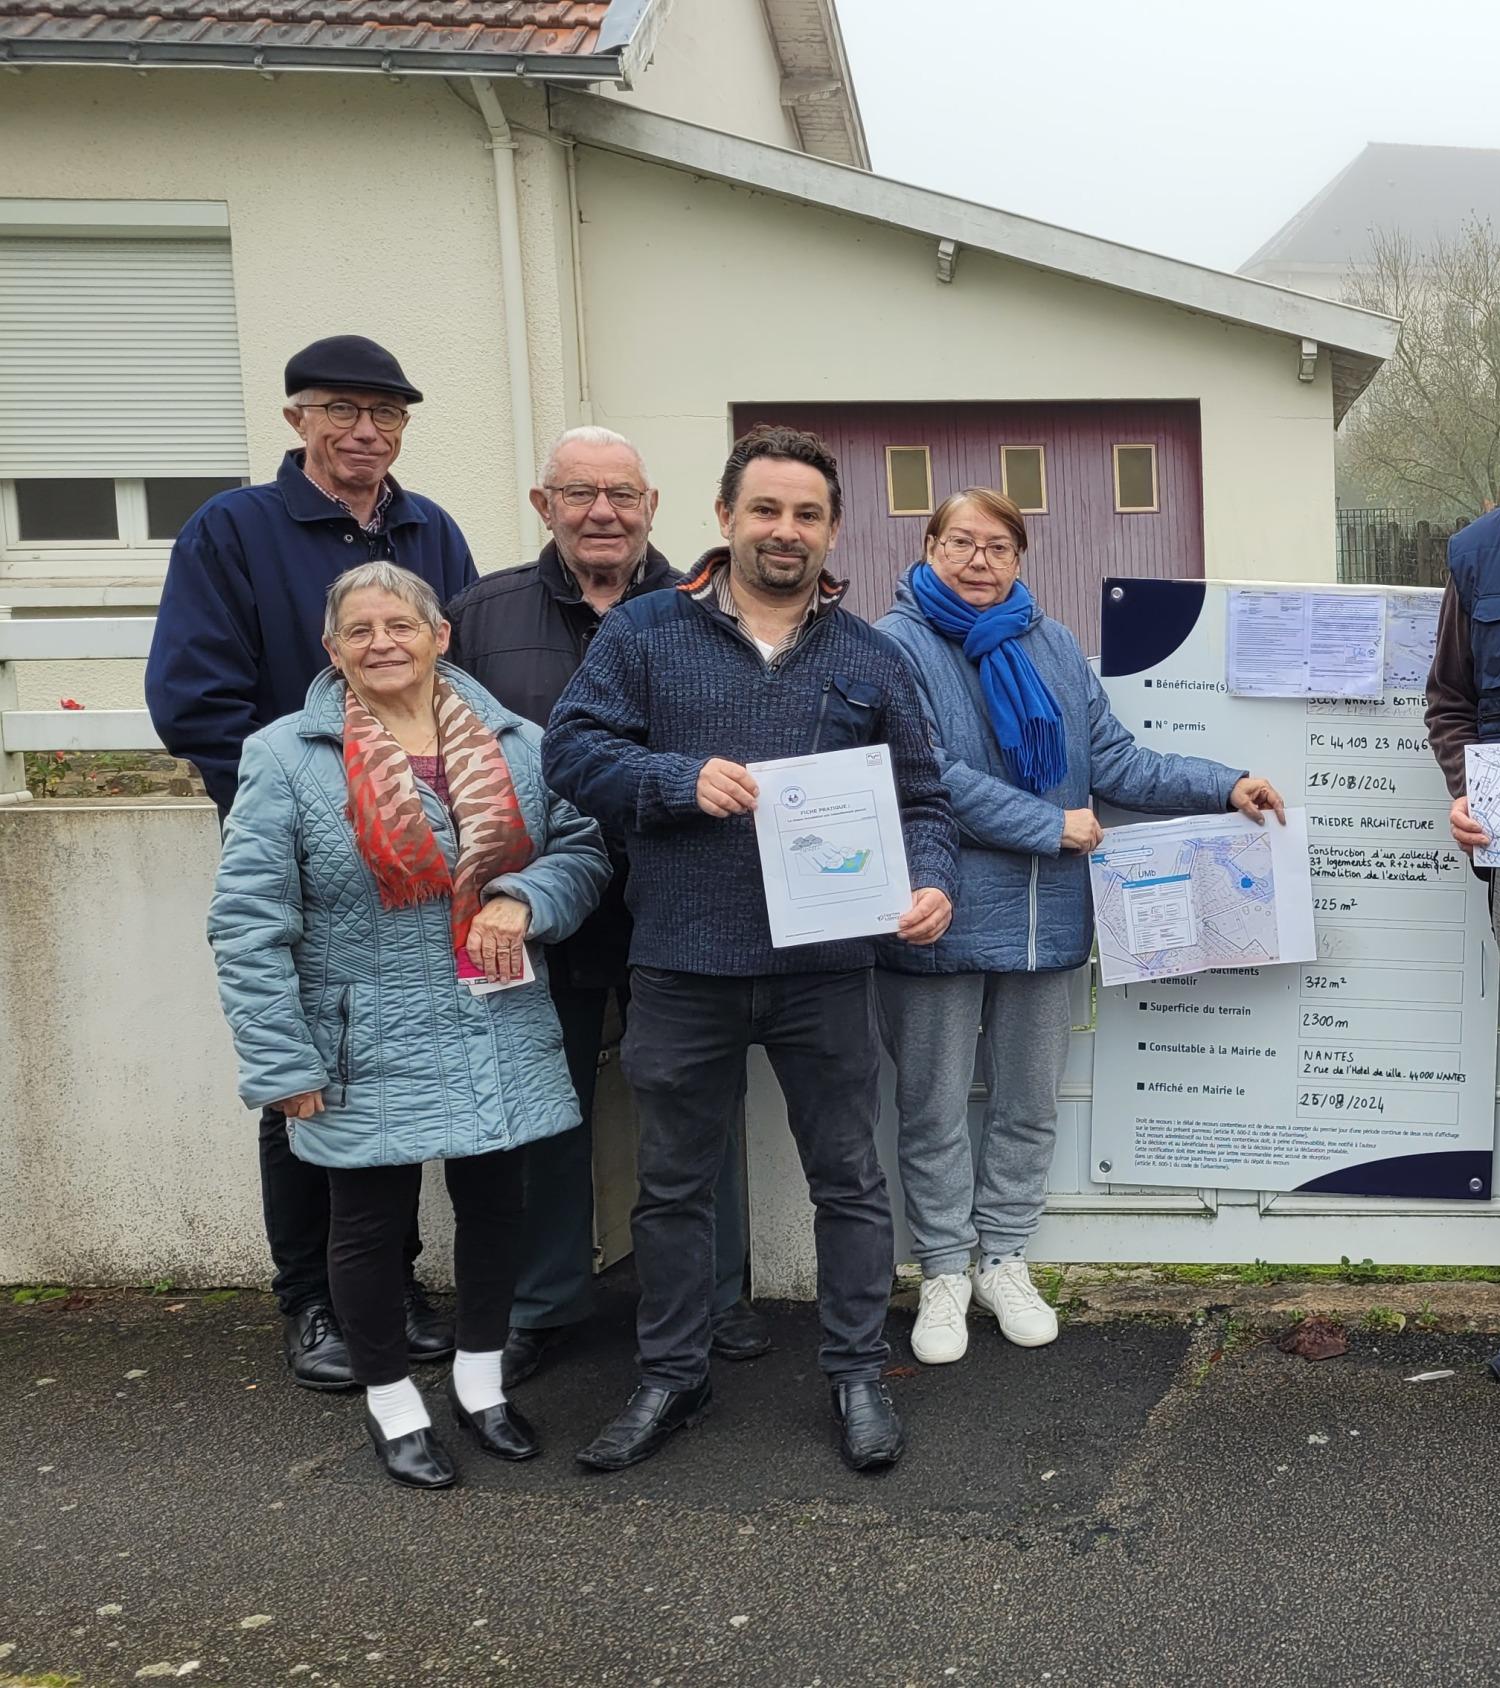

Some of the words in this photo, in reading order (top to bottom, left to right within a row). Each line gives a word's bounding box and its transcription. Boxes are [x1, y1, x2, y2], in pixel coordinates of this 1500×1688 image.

[1156, 679, 1229, 693] Bénéficiaire(s)
[1155, 720, 1168, 729] N°
[1172, 721, 1206, 732] permis
[1310, 733, 1325, 746] PC
[1375, 737, 1390, 749] 23
[1308, 844, 1365, 857] Construction
[1371, 849, 1396, 859] d'un
[1399, 850, 1439, 862] collectif
[1443, 852, 1458, 863] de
[1310, 857, 1321, 866] 37
[1327, 857, 1372, 869] logements
[1310, 866, 1361, 878] Démolition
[1364, 870, 1379, 879] de
[1383, 870, 1428, 881] l'existant
[1305, 975, 1327, 989] 372
[1150, 1002, 1199, 1014] Superficie
[1203, 1004, 1215, 1014] du
[1218, 1005, 1251, 1016] terrain
[1303, 1013, 1334, 1027] 2300
[1149, 1042, 1206, 1054] Consultable
[1209, 1044, 1215, 1054] à
[1218, 1045, 1227, 1055] la
[1231, 1046, 1261, 1057] Mairie
[1264, 1048, 1277, 1057] de
[1304, 1050, 1354, 1062] NANTES
[1303, 1063, 1311, 1073] 2
[1314, 1066, 1329, 1074] rue
[1332, 1066, 1344, 1075] de
[1372, 1068, 1383, 1077] de
[1437, 1071, 1466, 1083] NANTES
[1148, 1082, 1183, 1094] Affiché
[1186, 1085, 1199, 1094] en
[1202, 1085, 1233, 1096] Mairie
[1236, 1086, 1245, 1096] le
